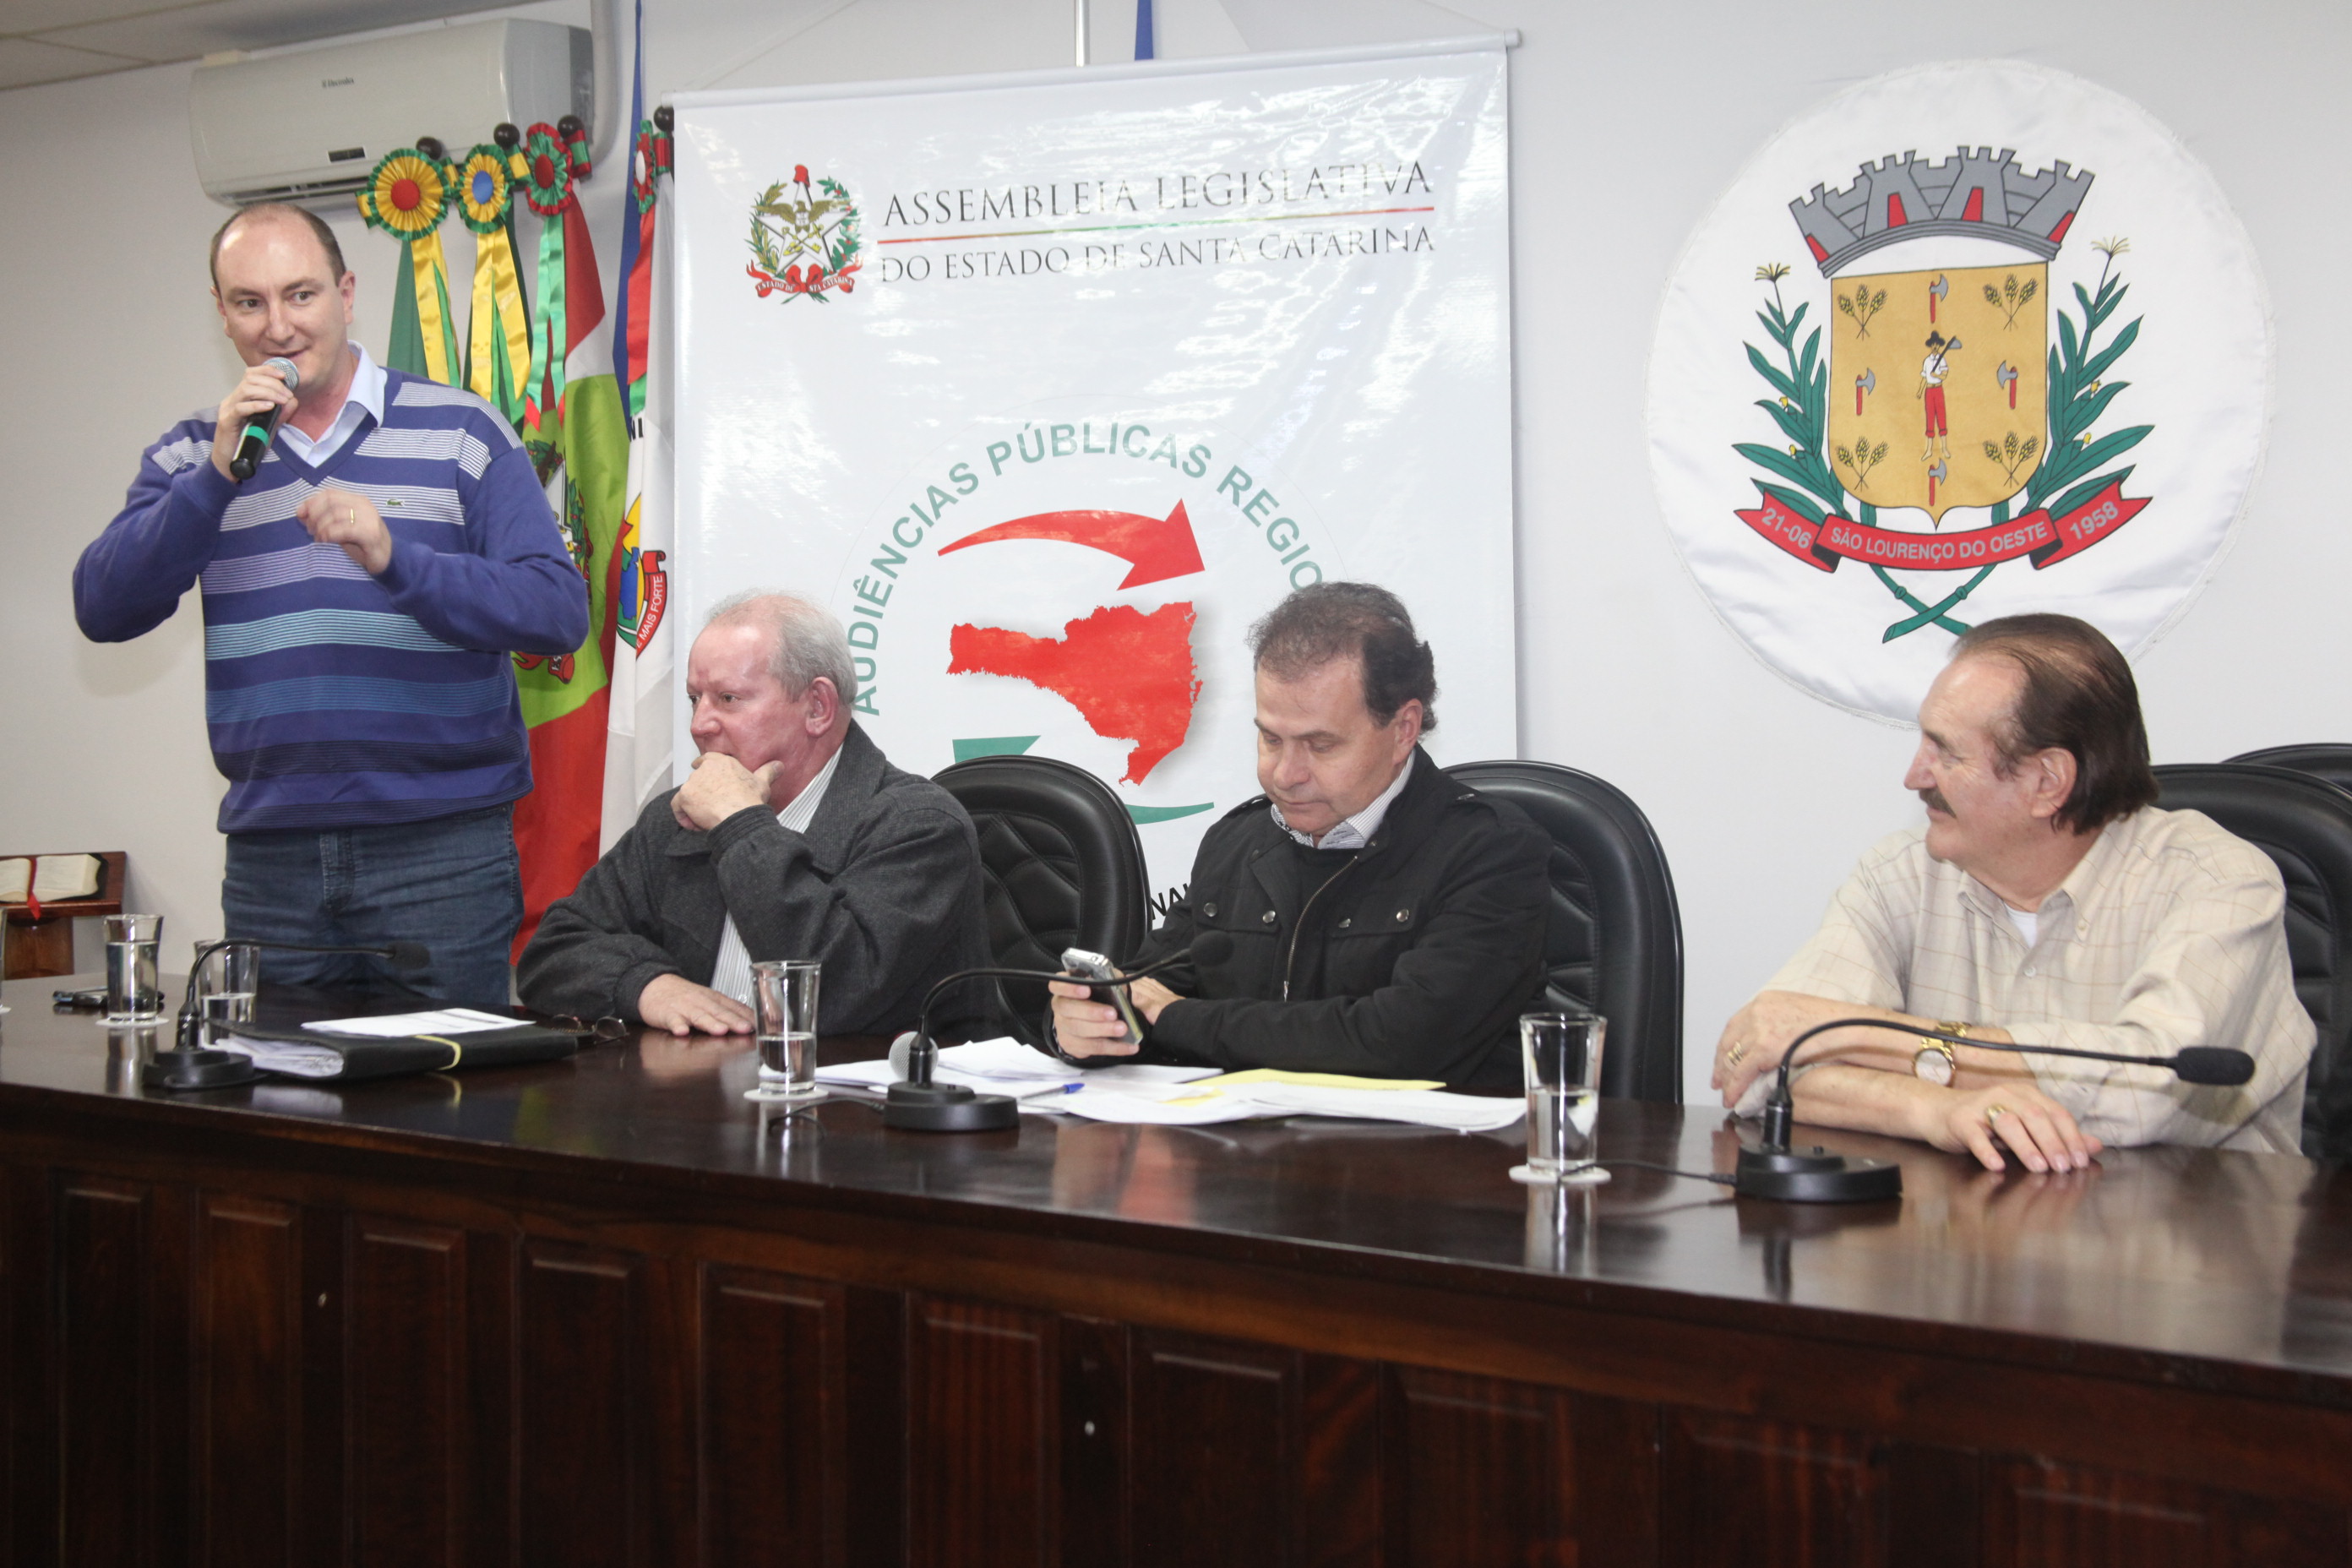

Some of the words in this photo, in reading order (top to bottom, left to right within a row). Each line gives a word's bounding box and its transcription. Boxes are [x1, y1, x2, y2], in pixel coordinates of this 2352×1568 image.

[884, 179, 1140, 226] ASSEMBLEIA
[1157, 160, 1433, 210] LEGISLATIVA
[881, 255, 931, 282] DO
[945, 247, 1070, 279] ESTADO
[1085, 243, 1126, 271] DE
[1140, 237, 1249, 269] SANTA
[1259, 226, 1435, 261] CATARINA
[1761, 507, 1812, 548] 21-06
[1831, 526, 1863, 550] SÃO
[1865, 536, 1956, 564] LOURENÇO
[1959, 540, 1985, 558] DO
[1990, 521, 2048, 553] OESTE
[2070, 501, 2119, 541] 1958
[847, 462, 979, 716] AUDIÊNCIAS
[986, 422, 1212, 478] PÚBLICAS
[639, 613, 657, 640] MAIS
[650, 574, 663, 613] FORTE
